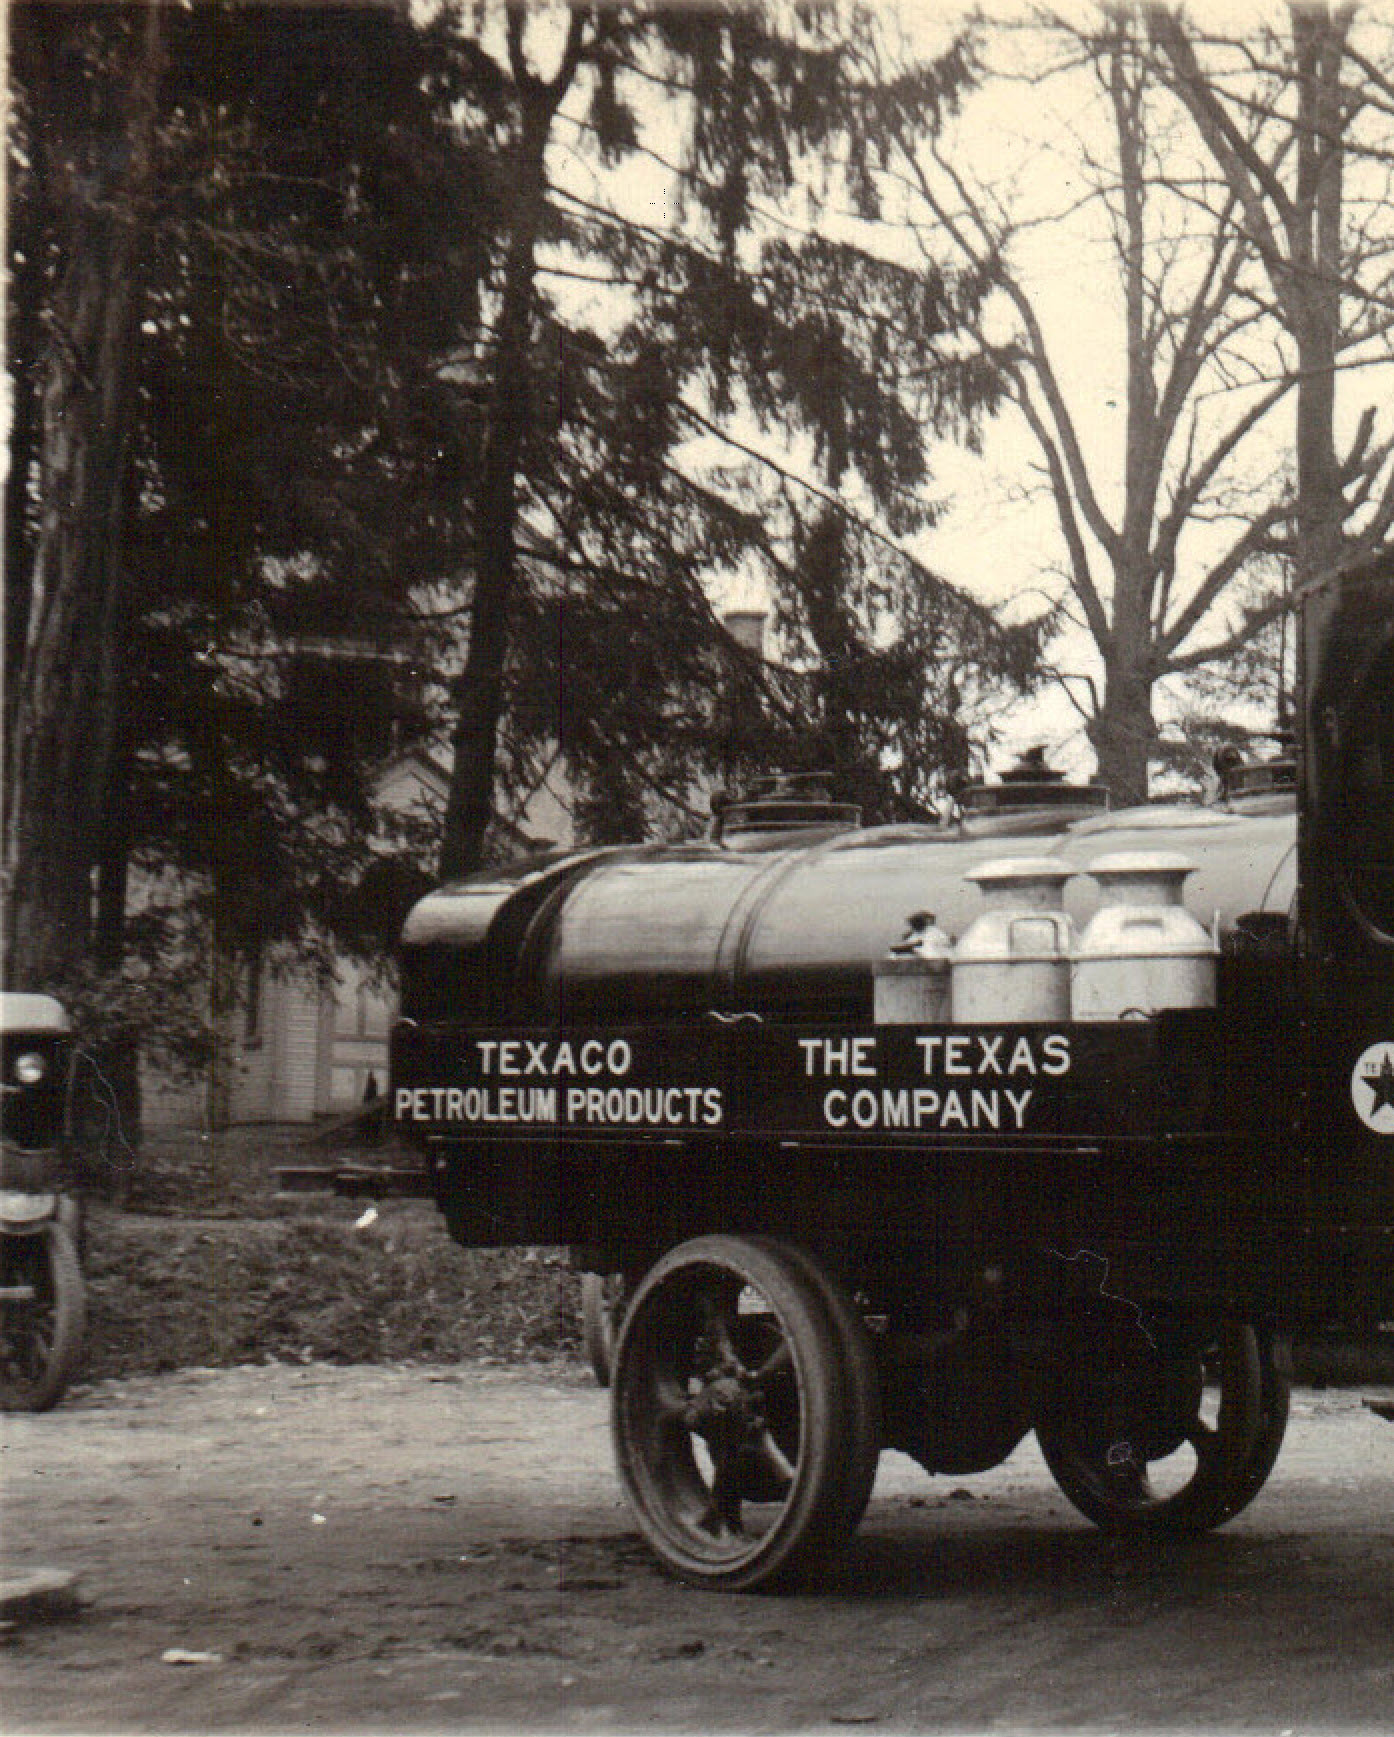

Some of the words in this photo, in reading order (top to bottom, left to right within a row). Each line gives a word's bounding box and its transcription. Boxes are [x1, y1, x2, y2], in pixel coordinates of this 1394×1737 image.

[476, 1039, 631, 1076] TEXACO
[798, 1037, 877, 1076] THE
[915, 1035, 1071, 1075] TEXAS
[395, 1087, 557, 1122] PETROLEUM
[566, 1087, 723, 1125] PRODUCTS
[823, 1089, 1033, 1129] COMPANY
